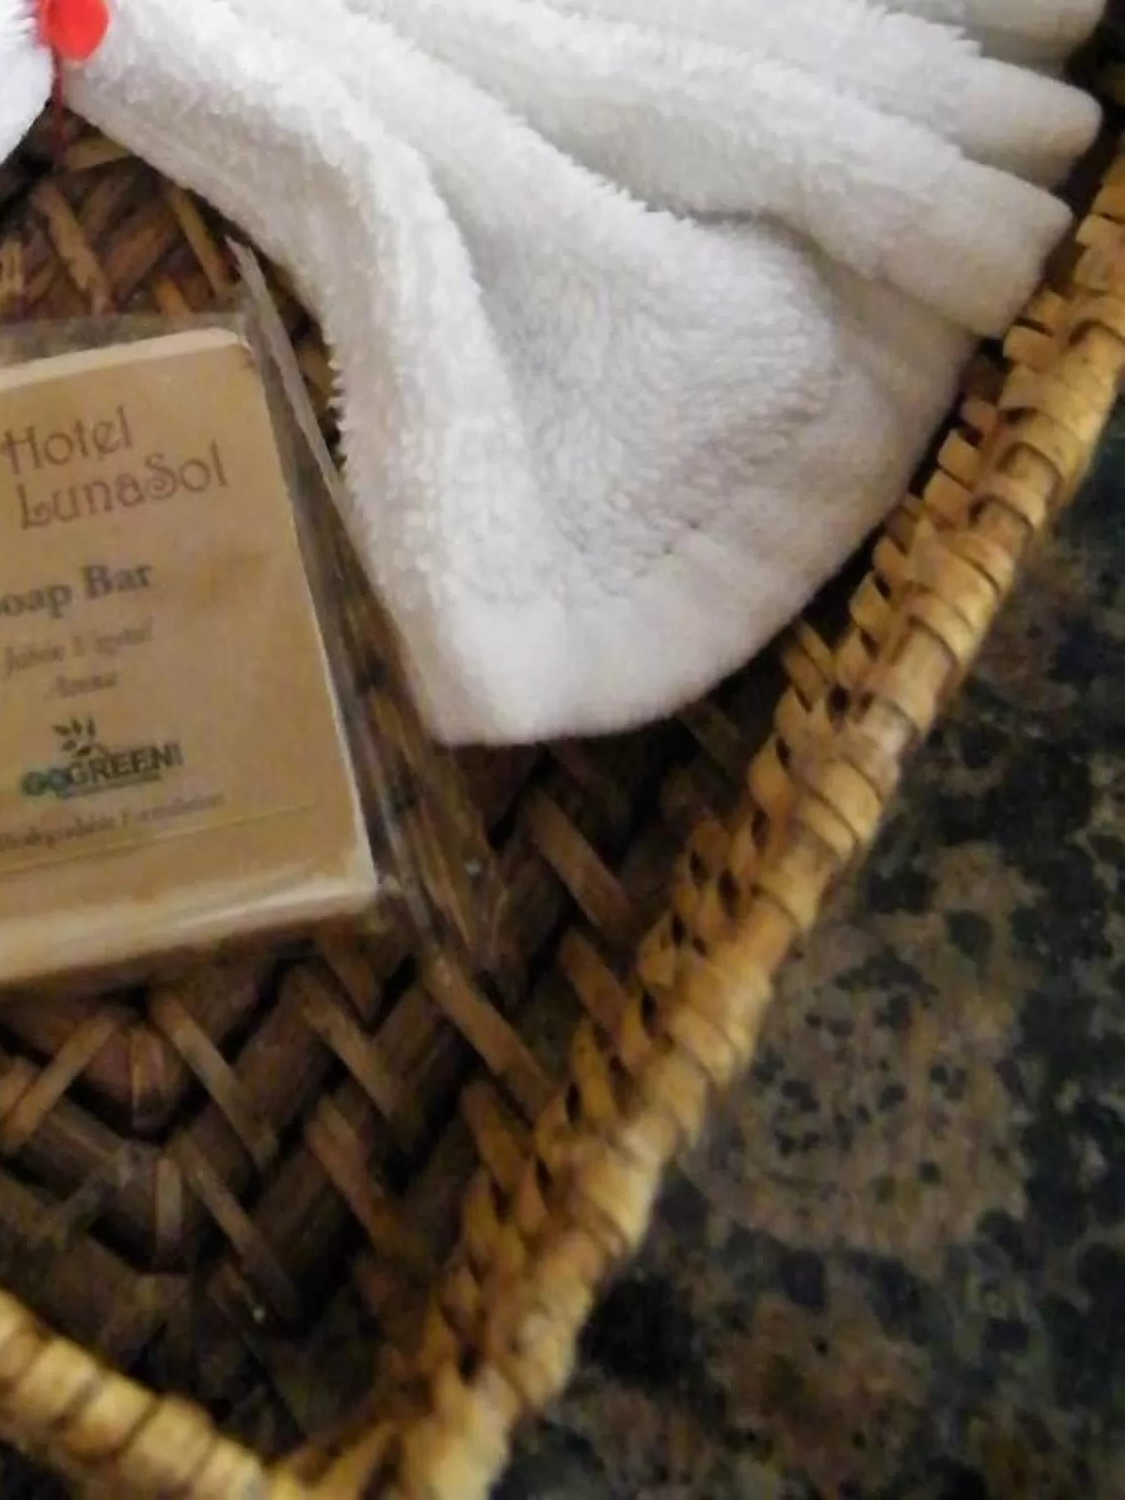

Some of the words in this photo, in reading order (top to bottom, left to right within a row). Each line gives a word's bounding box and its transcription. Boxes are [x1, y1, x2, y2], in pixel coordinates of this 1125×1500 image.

[0, 404, 133, 475] Hotel
[16, 438, 230, 530] LunaSol
[83, 563, 154, 599] Bar
